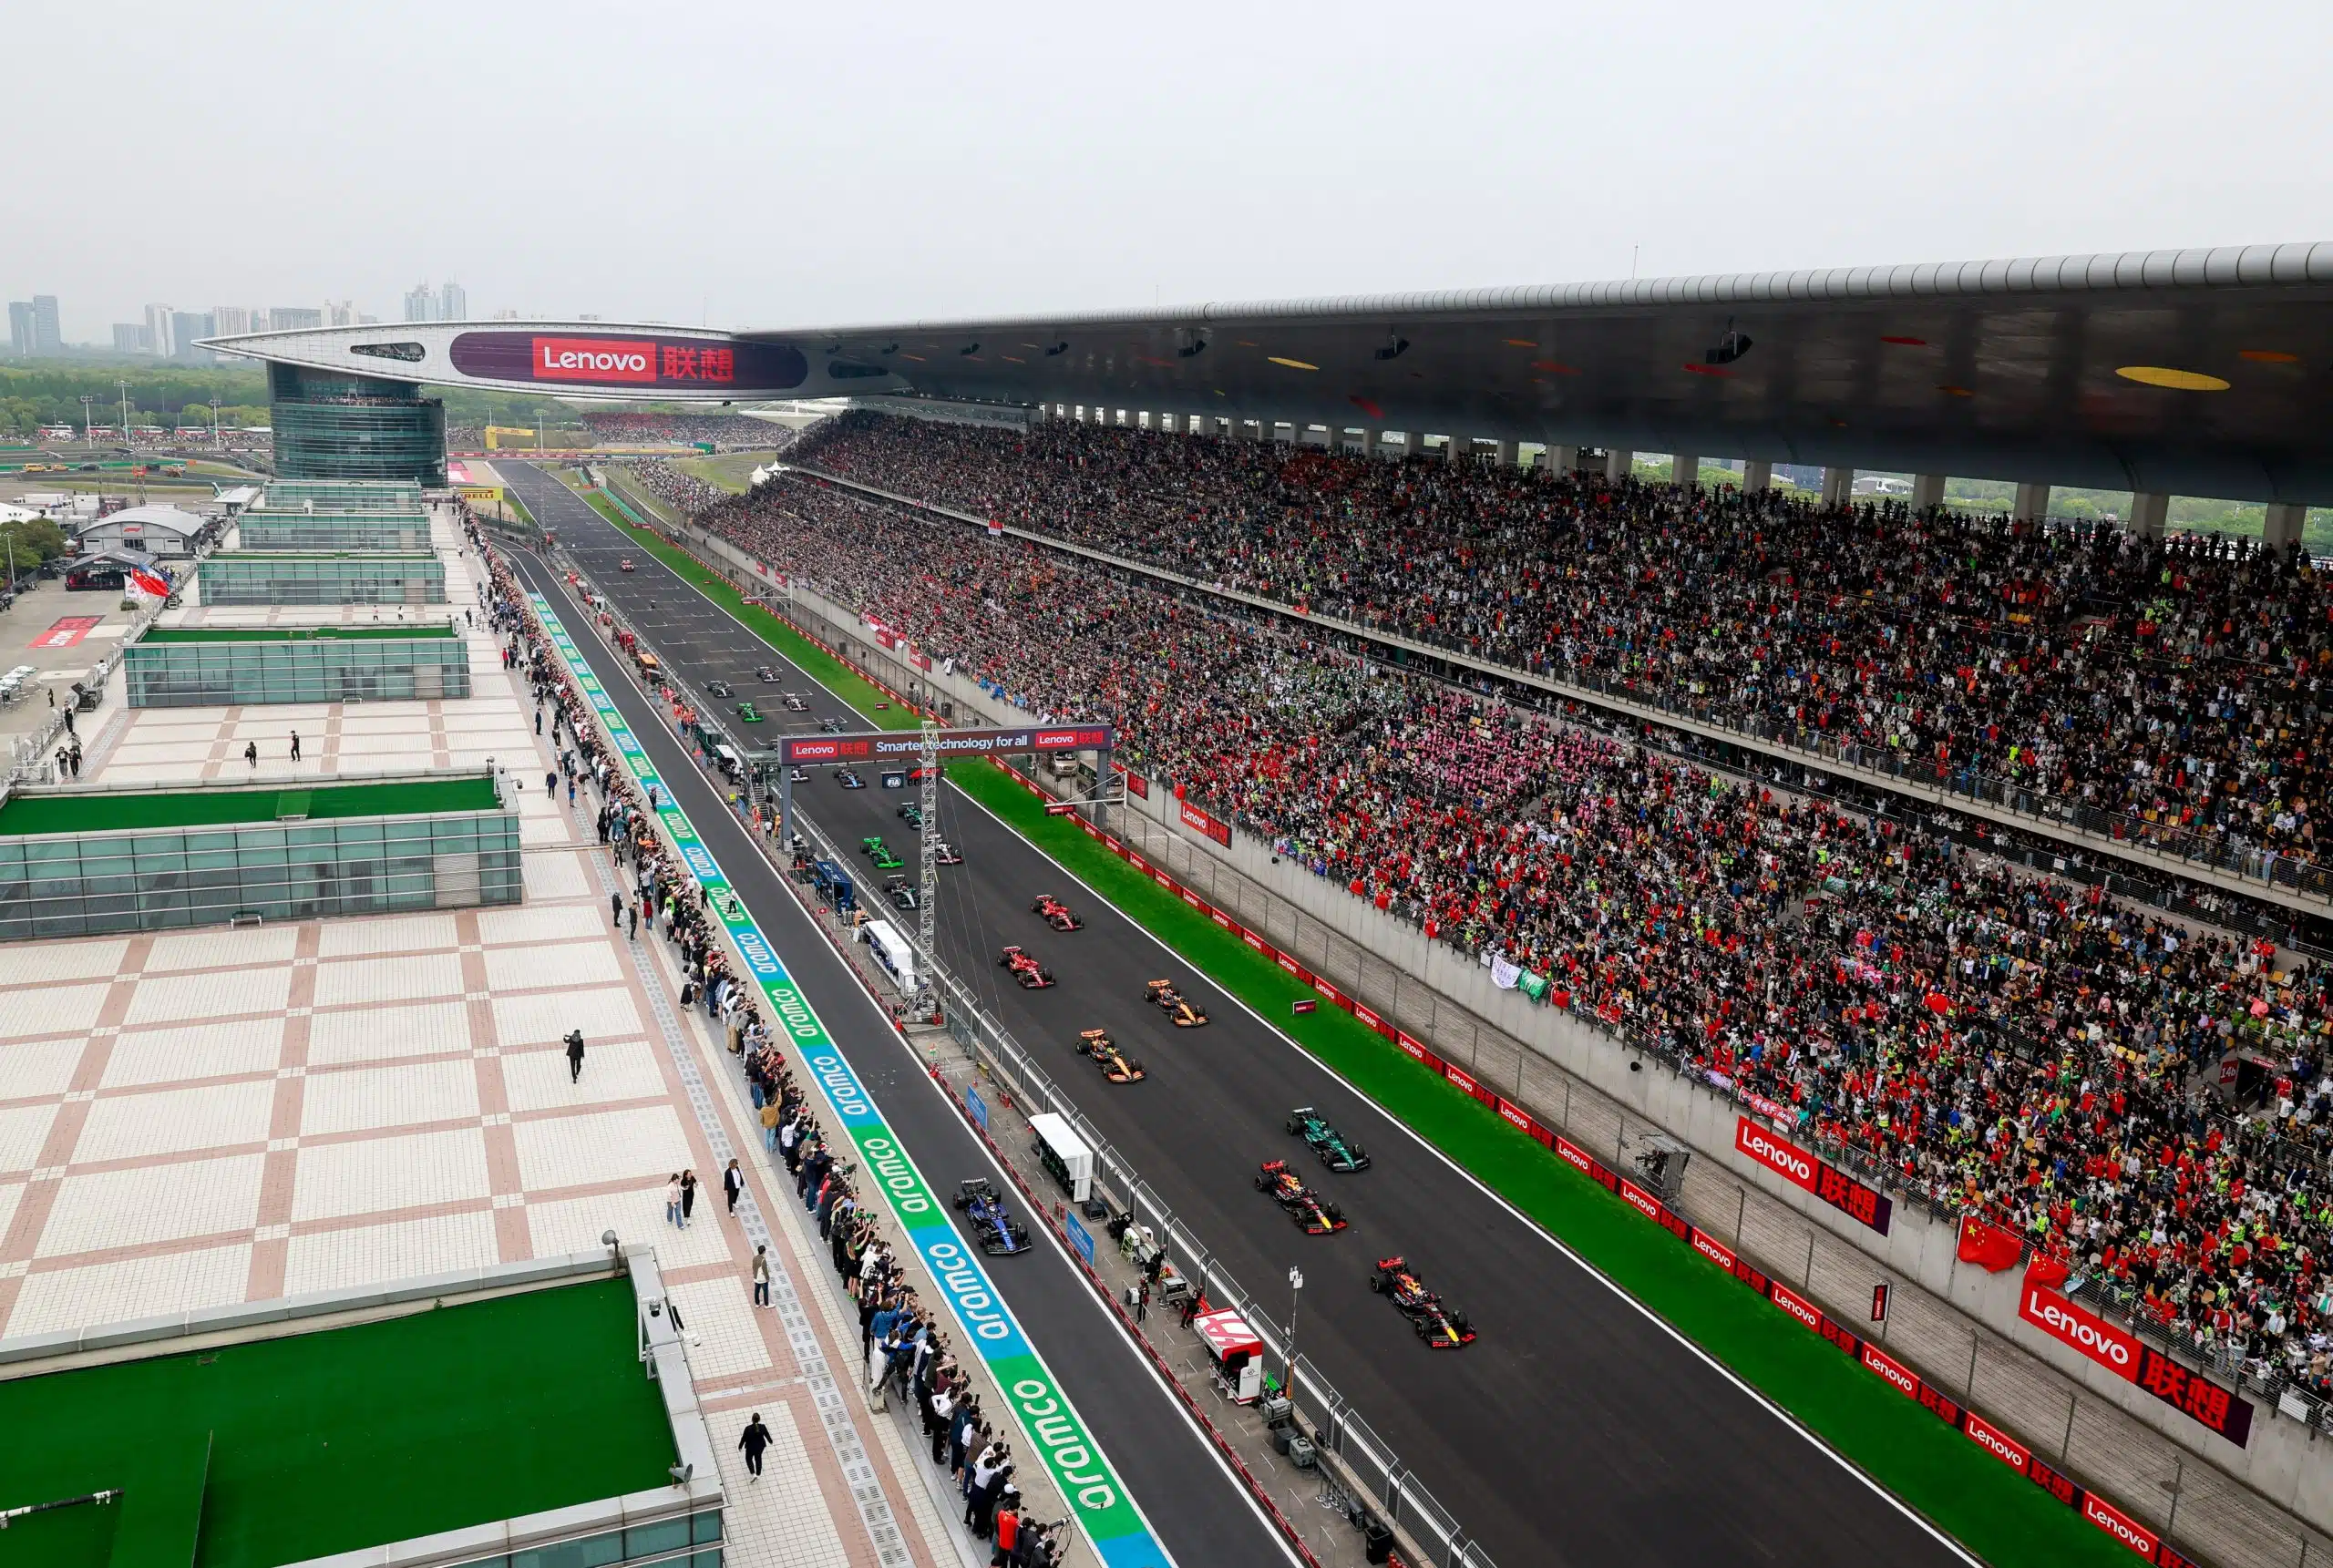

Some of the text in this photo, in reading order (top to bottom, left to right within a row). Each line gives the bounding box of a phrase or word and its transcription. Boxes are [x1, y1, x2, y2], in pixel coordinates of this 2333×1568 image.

[544, 346, 734, 382] Lenovo 联想
[796, 743, 835, 754] Lenovo
[876, 740, 923, 753] Smarter
[996, 735, 1013, 747] for
[1015, 735, 1028, 746] all
[1039, 735, 1074, 744] Lenovo
[887, 778, 901, 786] FIA
[1183, 805, 1206, 828] Lenovo
[684, 847, 716, 876] aramco
[1213, 911, 1228, 927] Lenovo
[737, 933, 777, 974] aramco
[1244, 931, 1261, 948] Lenovo
[1279, 954, 1297, 973] Lenovo
[1315, 979, 1335, 999] Lenovo
[771, 989, 818, 1038] aramco
[1356, 1007, 1377, 1028] Lenovo
[1399, 1036, 1422, 1058] Lenovo
[813, 1056, 868, 1116] aramco
[1448, 1068, 1473, 1091] Lenovo
[2221, 1066, 2236, 1079] 14b
[1500, 1103, 1527, 1129] Lenovo
[1558, 1142, 1588, 1170] Lenovo
[863, 1138, 930, 1213] aramco
[1742, 1125, 1877, 1225] Lenovo 联想
[1623, 1185, 1656, 1215] Lenovo
[1694, 1235, 1732, 1267] Lenovo
[929, 1243, 1009, 1339] aramco
[1774, 1289, 1816, 1325] Lenovo
[1865, 1351, 1912, 1391] Lenovo
[2030, 1290, 2232, 1433] Lenovo 联想
[1013, 1379, 1115, 1509] aramco
[1968, 1420, 2075, 1504] Lenovo 联想
[2087, 1501, 2149, 1553] Lenovo
